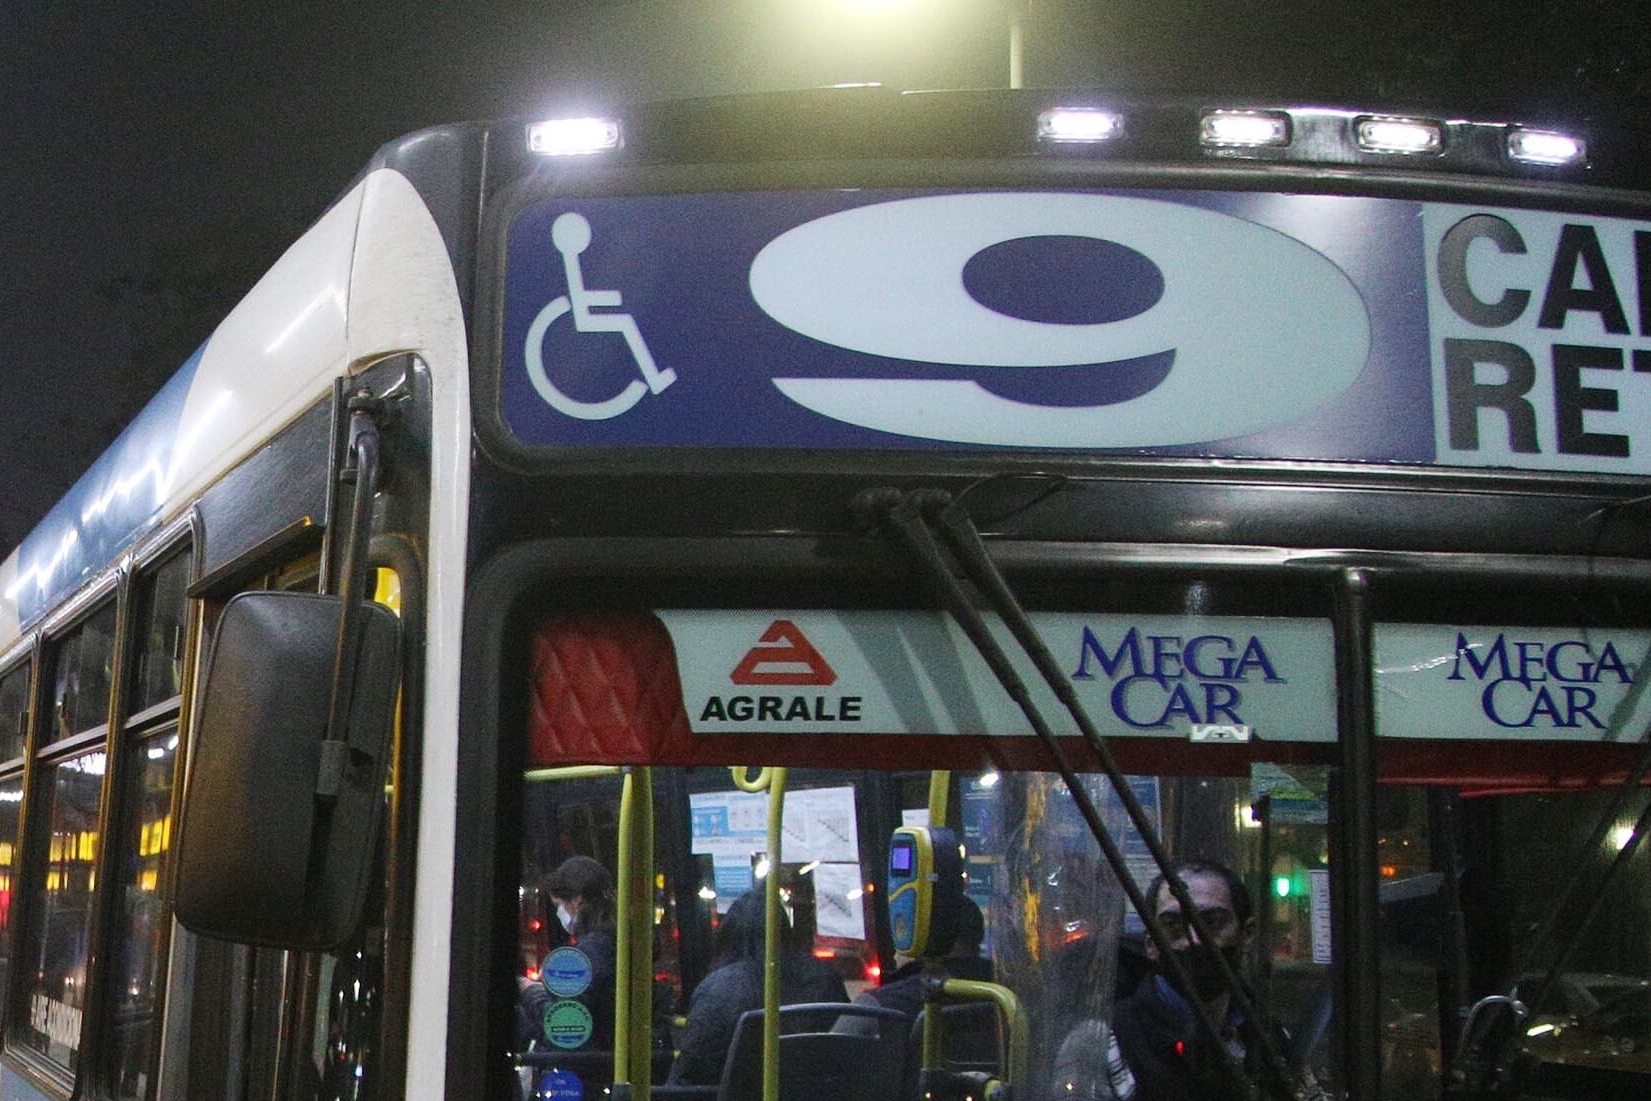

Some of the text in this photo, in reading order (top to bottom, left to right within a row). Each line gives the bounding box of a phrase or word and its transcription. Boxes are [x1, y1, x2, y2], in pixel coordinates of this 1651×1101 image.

[1437, 213, 1651, 336] CA
[749, 192, 1372, 448] 9
[1444, 338, 1651, 457] RE
[1072, 625, 1285, 684] MEGA
[1447, 631, 1635, 683] MEGA
[700, 695, 862, 722] AGRALE
[1110, 673, 1245, 729] CAR
[1481, 678, 1608, 729] CAR
